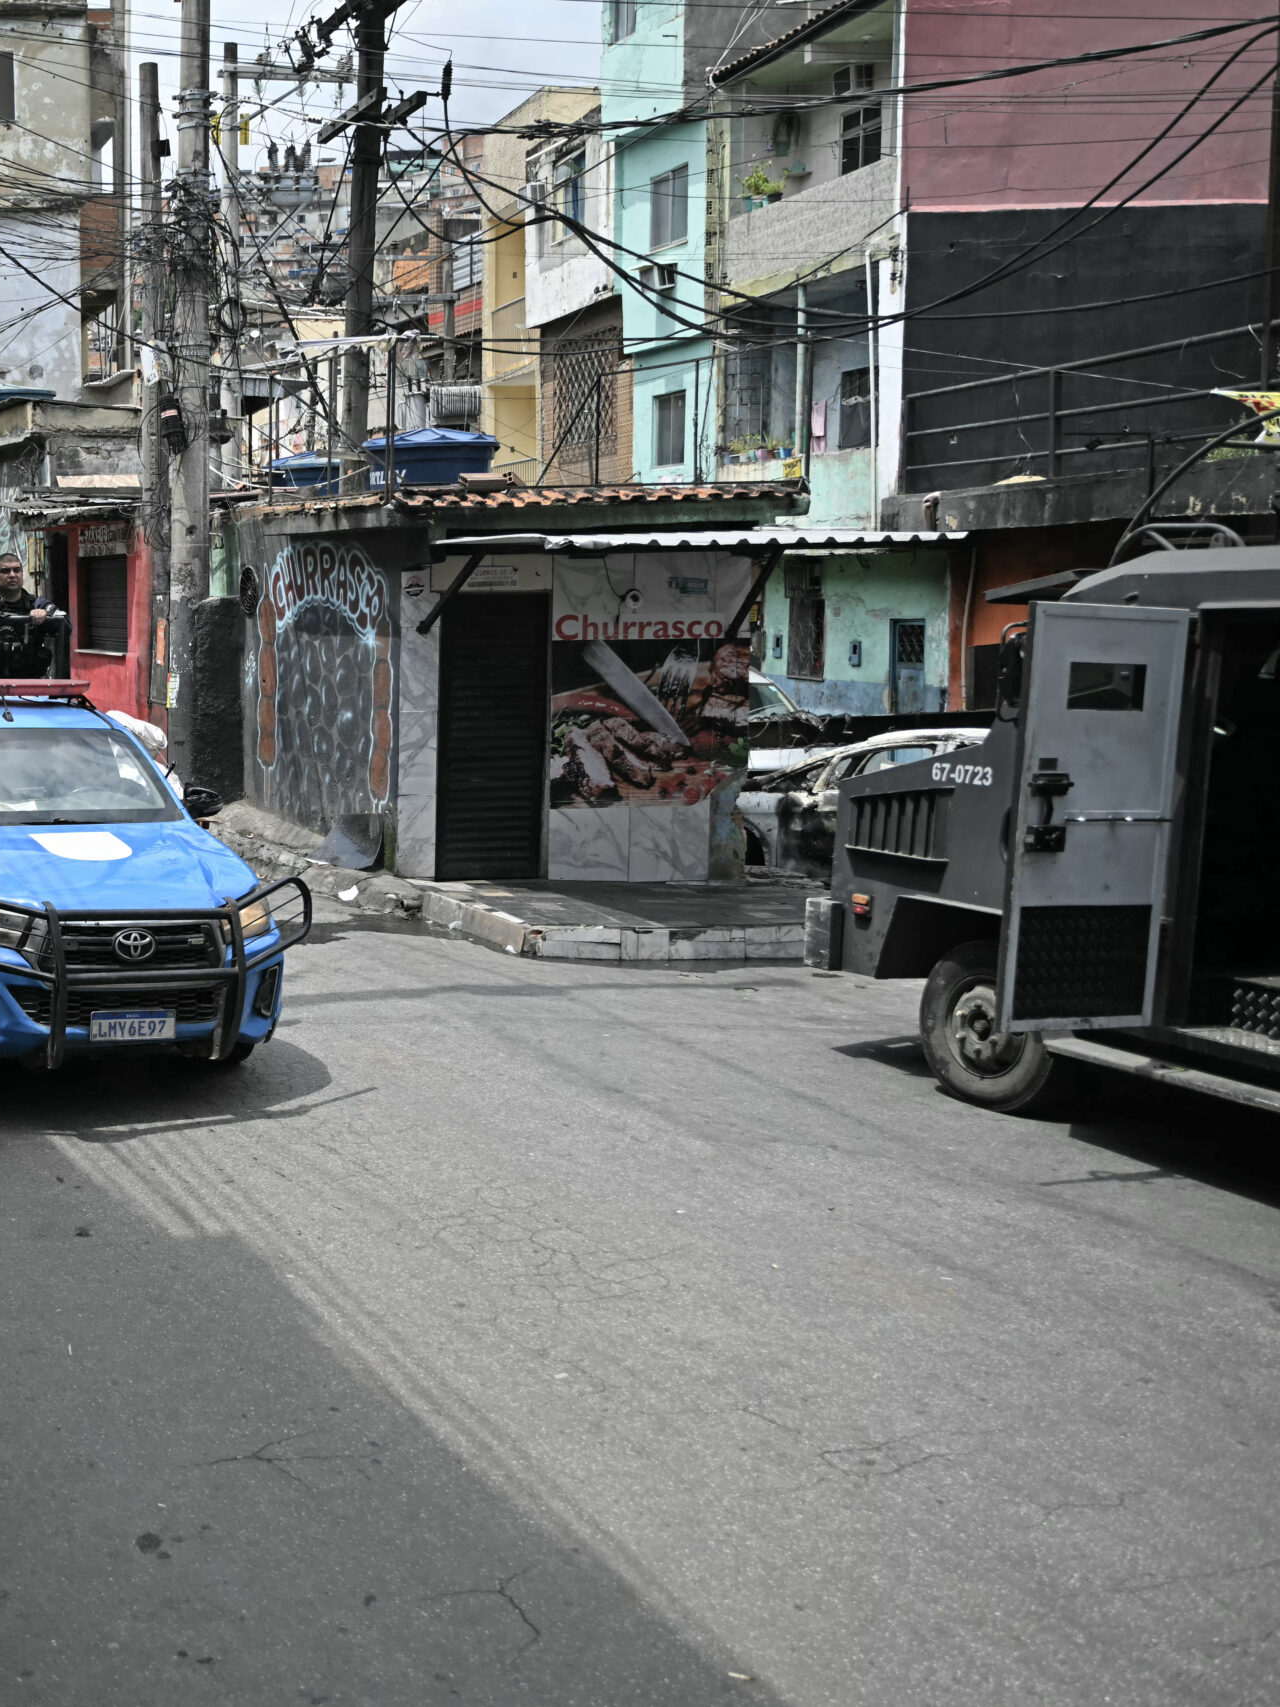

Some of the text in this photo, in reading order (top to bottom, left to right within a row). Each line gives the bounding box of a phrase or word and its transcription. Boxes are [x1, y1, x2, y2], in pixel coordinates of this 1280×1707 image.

[271, 545, 386, 632] CHURRASCO
[555, 614, 723, 641] Churrasco
[932, 762, 992, 786] 67-0723
[98, 1019, 166, 1038] LMY6E97
